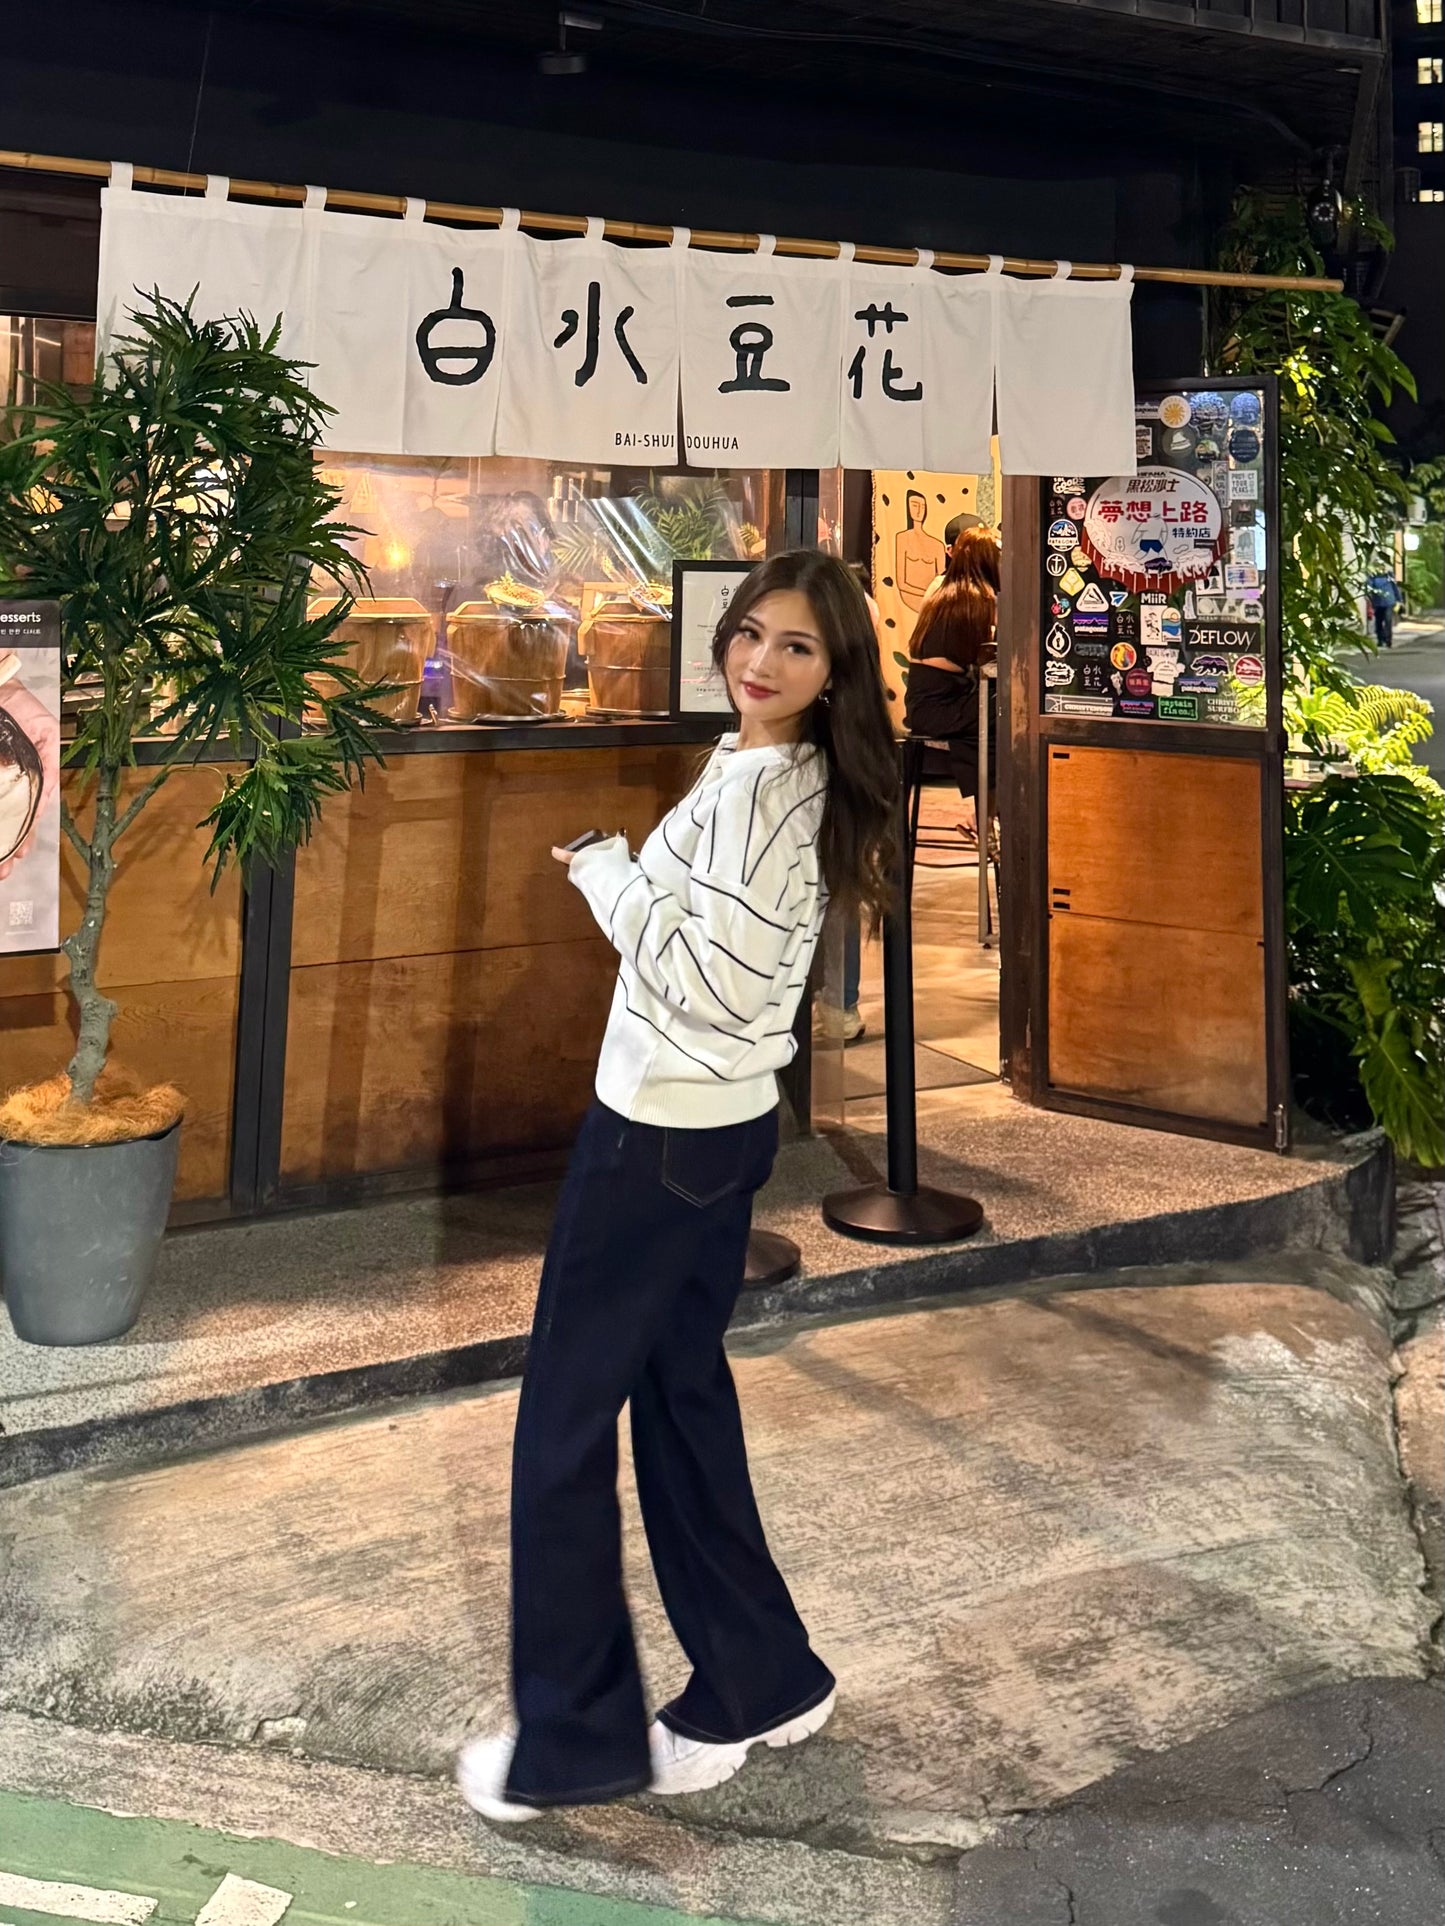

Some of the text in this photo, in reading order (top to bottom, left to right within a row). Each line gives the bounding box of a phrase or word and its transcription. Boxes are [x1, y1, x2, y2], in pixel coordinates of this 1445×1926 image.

[416, 267, 923, 402] 白水豆花
[615, 432, 739, 450] BAI-SHUI DOUHUA
[1098, 501, 1208, 523] 夢想上路
[1172, 527, 1211, 538] 特約店
[1141, 592, 1167, 604] MiiR
[0, 611, 41, 623] esserts
[1117, 613, 1134, 623] 白水
[1074, 625, 1108, 634] patagonia
[1117, 625, 1134, 634] 豆花
[1189, 625, 1256, 652] DEFLOW
[1083, 664, 1101, 675] 白水
[1083, 676, 1102, 687] 豆花
[1163, 706, 1177, 714] fin
